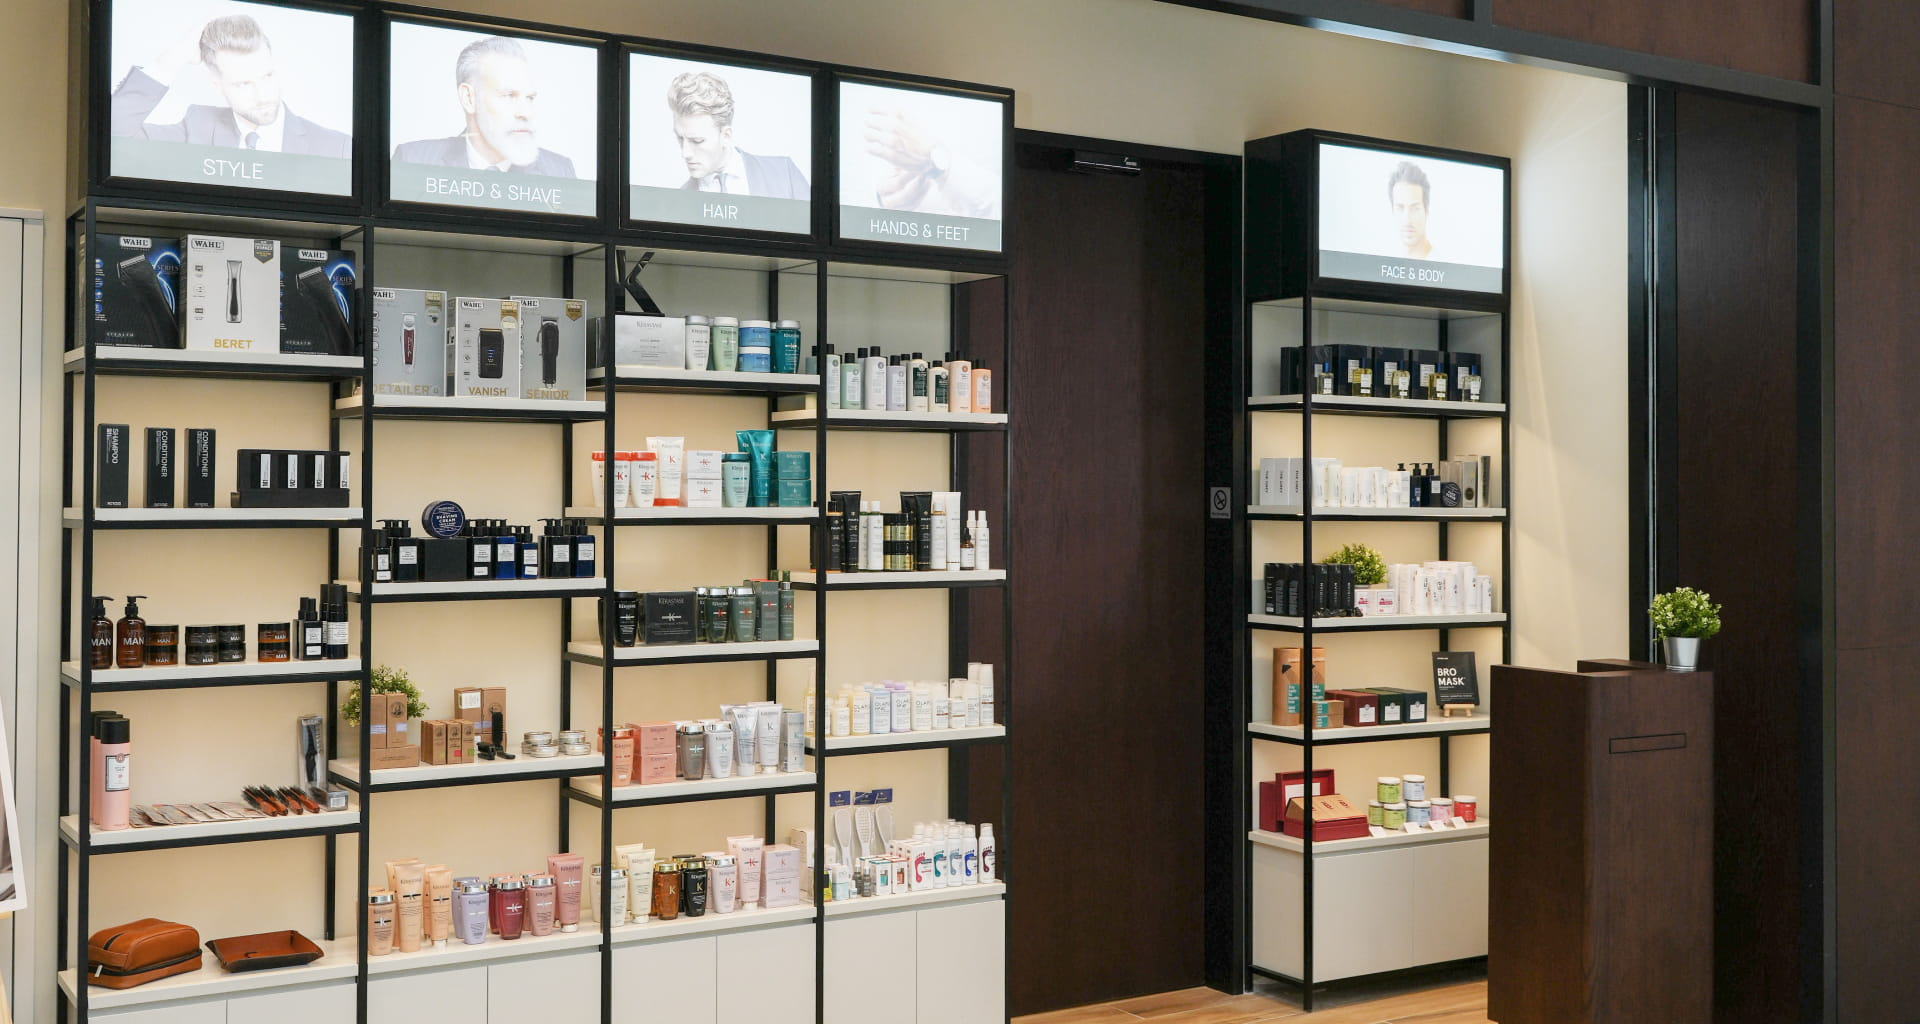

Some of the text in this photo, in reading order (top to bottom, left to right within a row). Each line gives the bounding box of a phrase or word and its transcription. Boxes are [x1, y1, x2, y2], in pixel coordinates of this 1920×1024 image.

[203, 159, 263, 180] STYLE
[426, 178, 562, 205] BEARD & SHAVE
[703, 204, 738, 221] HAIR
[870, 219, 969, 242] HANDS & FEET
[122, 239, 149, 247] WAHL
[195, 240, 221, 249] WAHL
[301, 250, 325, 259] WAHL
[1381, 265, 1445, 283] FACE & BODY
[615, 249, 665, 316] K
[463, 301, 483, 309] WAHL
[214, 338, 253, 349] BERET
[468, 386, 507, 396] VANISH
[526, 388, 569, 399] SENIOR
[111, 428, 119, 464] SHAMPOO
[160, 430, 168, 478] CONDITIONER
[201, 431, 209, 478] CONDITIONER
[92, 637, 111, 647] MAN
[123, 637, 144, 646] MAN
[1438, 668, 1456, 677] BRO
[1439, 677, 1464, 685] MASK
